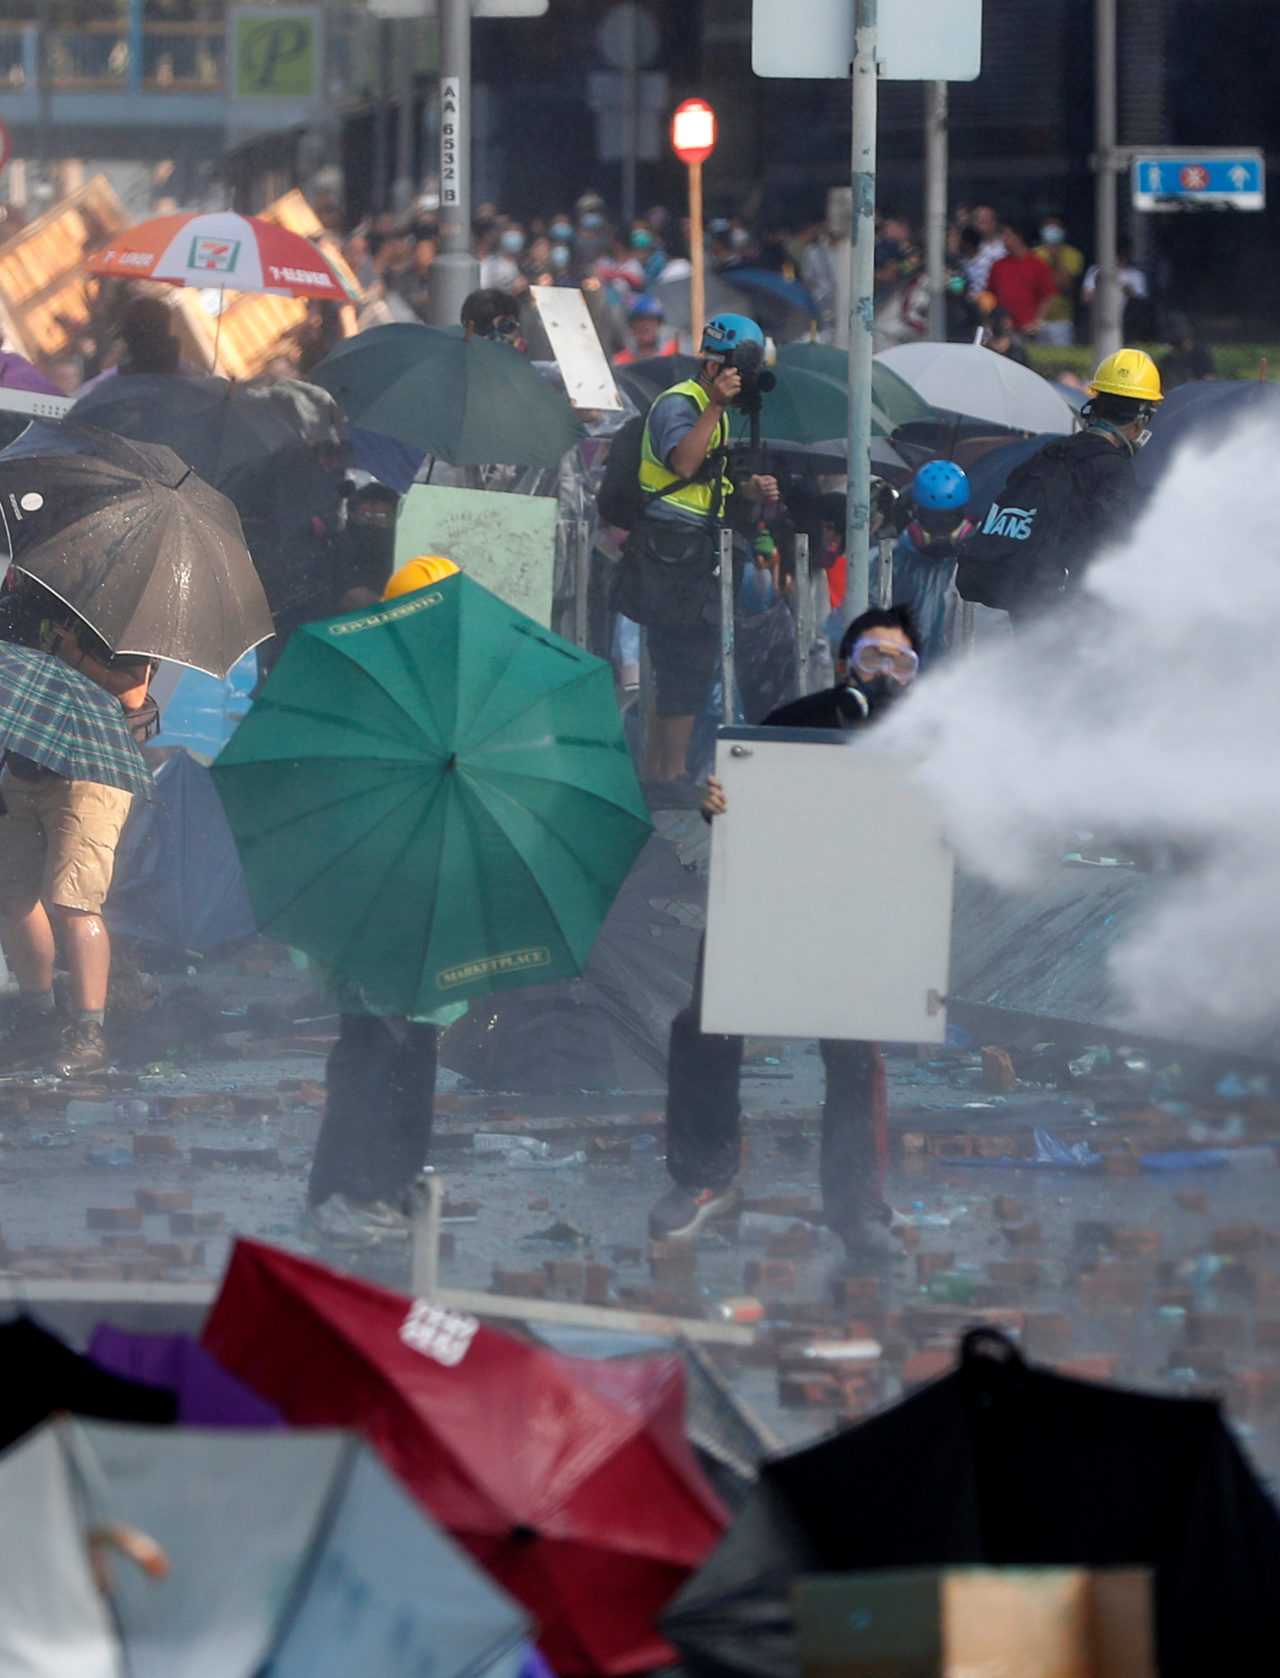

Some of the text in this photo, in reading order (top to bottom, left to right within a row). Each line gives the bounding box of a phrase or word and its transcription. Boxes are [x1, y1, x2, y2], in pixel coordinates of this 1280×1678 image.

[443, 85, 456, 202] AA 6532 B
[982, 502, 1037, 540] VANS
